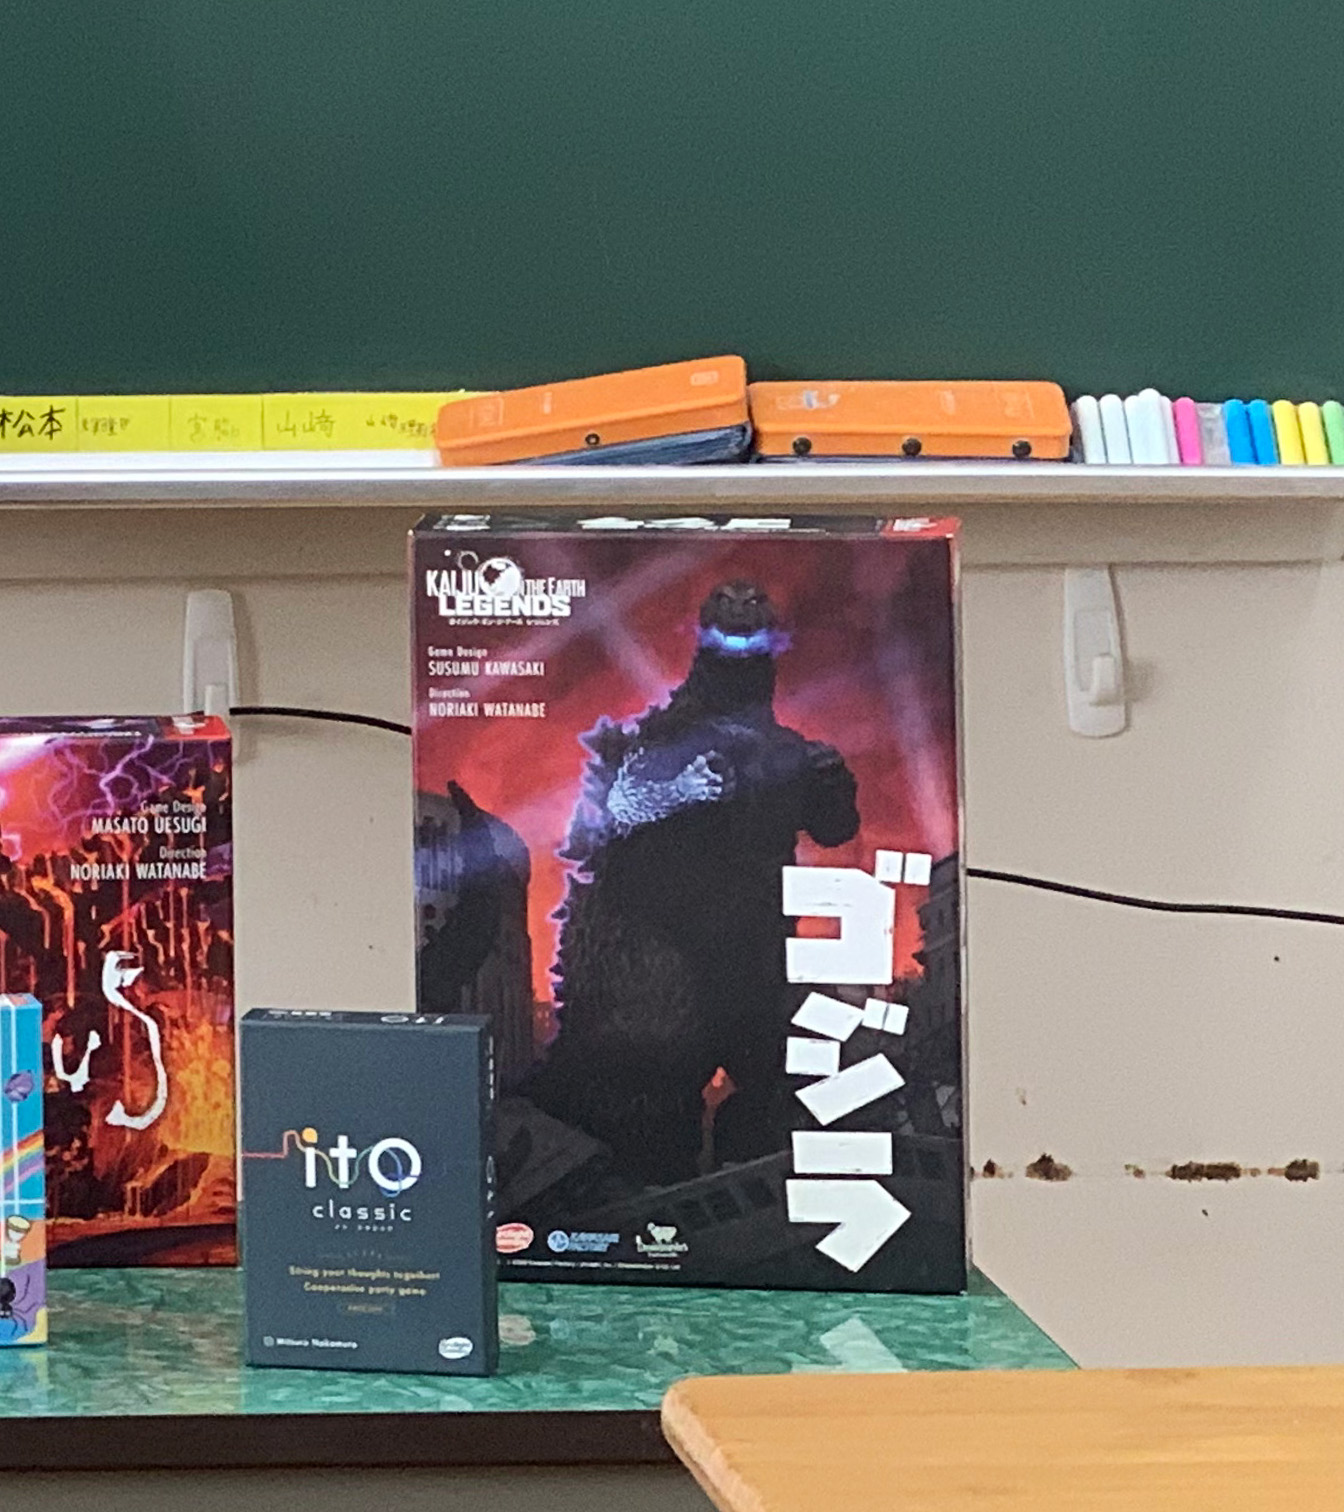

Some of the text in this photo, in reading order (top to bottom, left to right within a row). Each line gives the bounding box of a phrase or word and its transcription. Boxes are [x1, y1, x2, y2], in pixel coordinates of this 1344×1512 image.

[425, 569, 480, 597] KAIJU
[438, 594, 572, 617] LEGENDS
[428, 661, 546, 677] SUSUMU KAWASAKI
[428, 702, 547, 718] NORIAKI WATANABE
[91, 816, 208, 834] MASATO UESUGI
[70, 861, 208, 881] NORIAKI WATANABE
[781, 849, 933, 1274] ゴジラ
[301, 1127, 423, 1192] ito
[312, 1198, 413, 1222] classic
